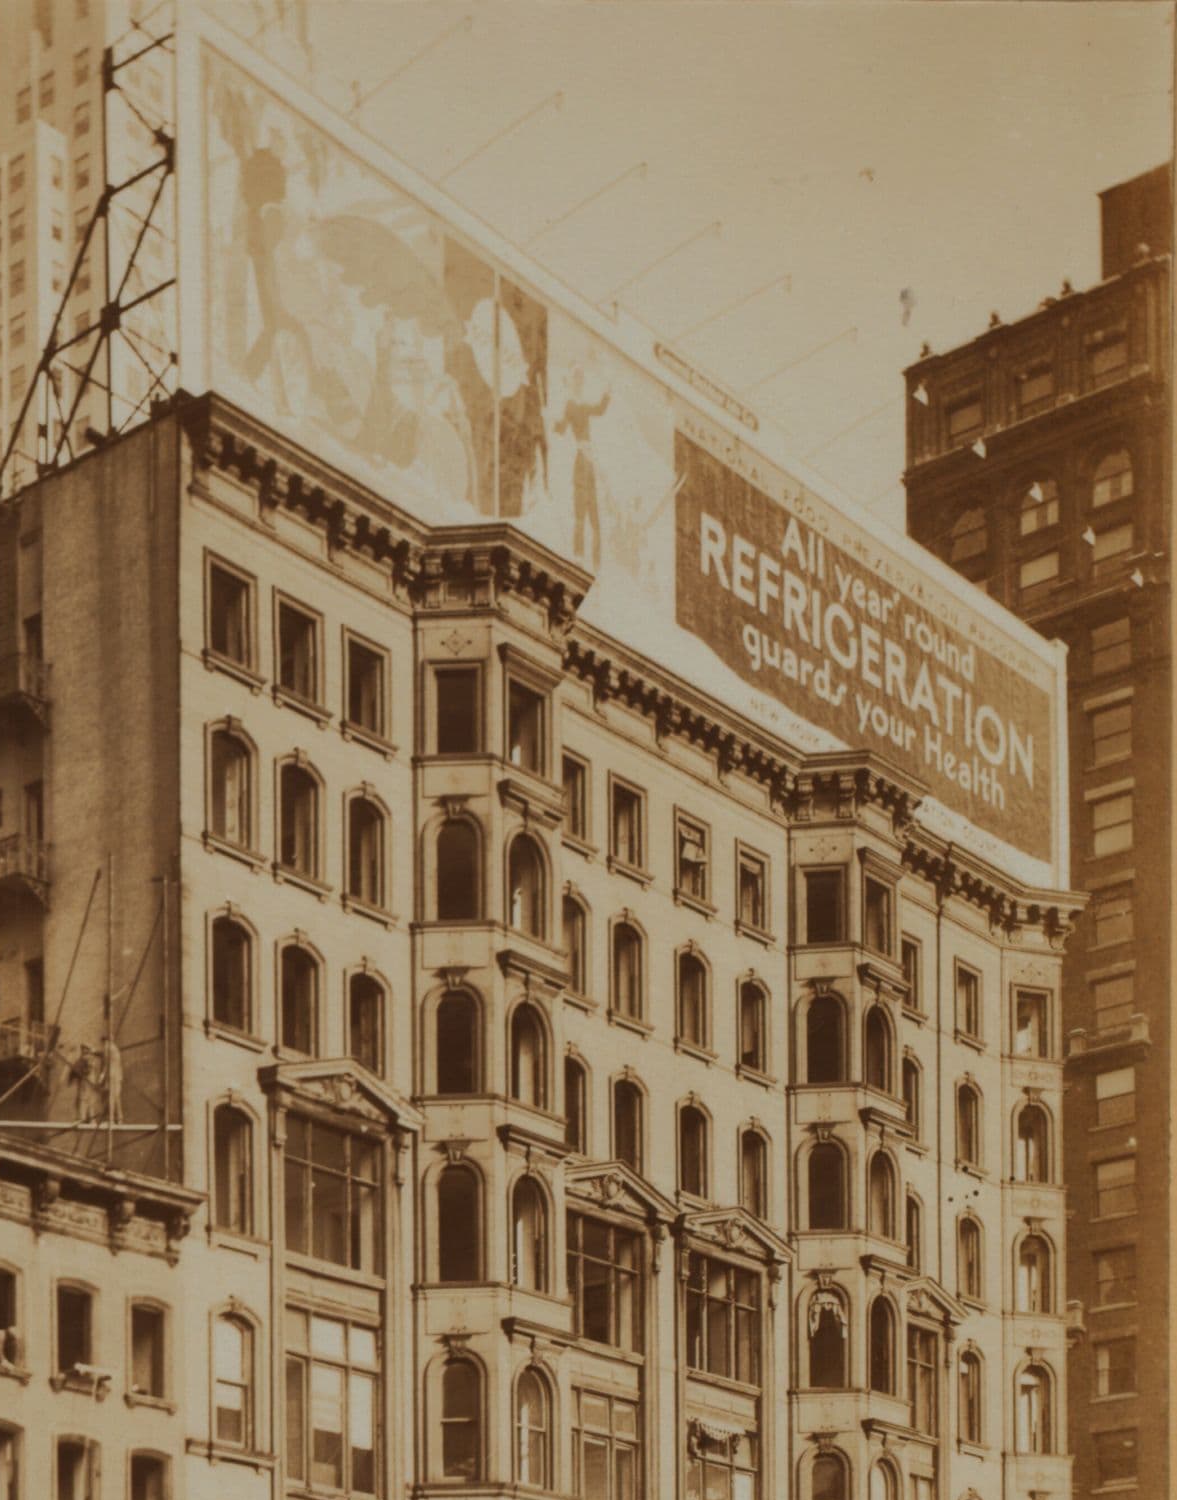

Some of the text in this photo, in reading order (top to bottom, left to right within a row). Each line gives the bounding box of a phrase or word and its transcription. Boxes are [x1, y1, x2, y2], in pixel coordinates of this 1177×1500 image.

[700, 511, 1035, 789] REFRIGERATION
[781, 516, 824, 582] All
[904, 617, 975, 684] round
[742, 624, 1006, 810] guards your Health
